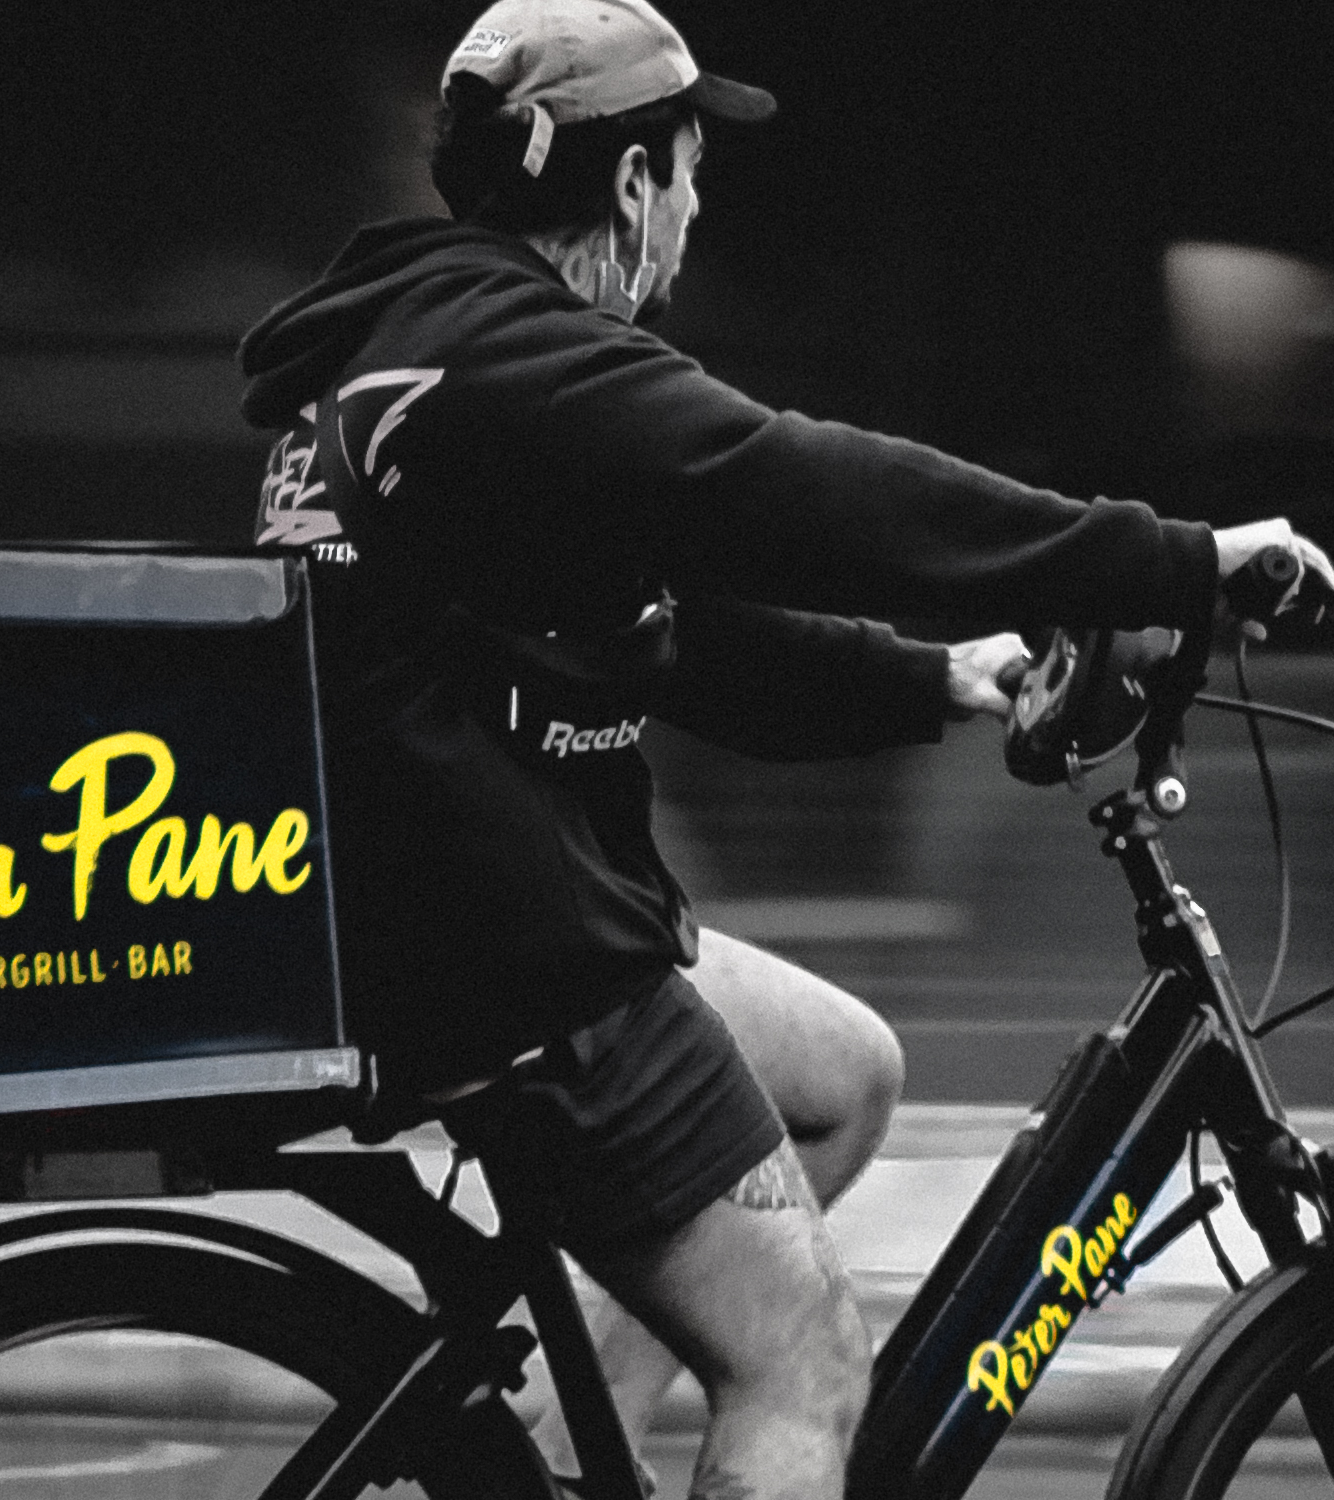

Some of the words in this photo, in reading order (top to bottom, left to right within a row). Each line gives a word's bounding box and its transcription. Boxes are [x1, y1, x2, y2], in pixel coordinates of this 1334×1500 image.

[41, 731, 311, 921] Pane
[129, 941, 192, 979] BAR
[968, 1304, 1071, 1416] Peter
[1042, 1192, 1137, 1300] Pane
